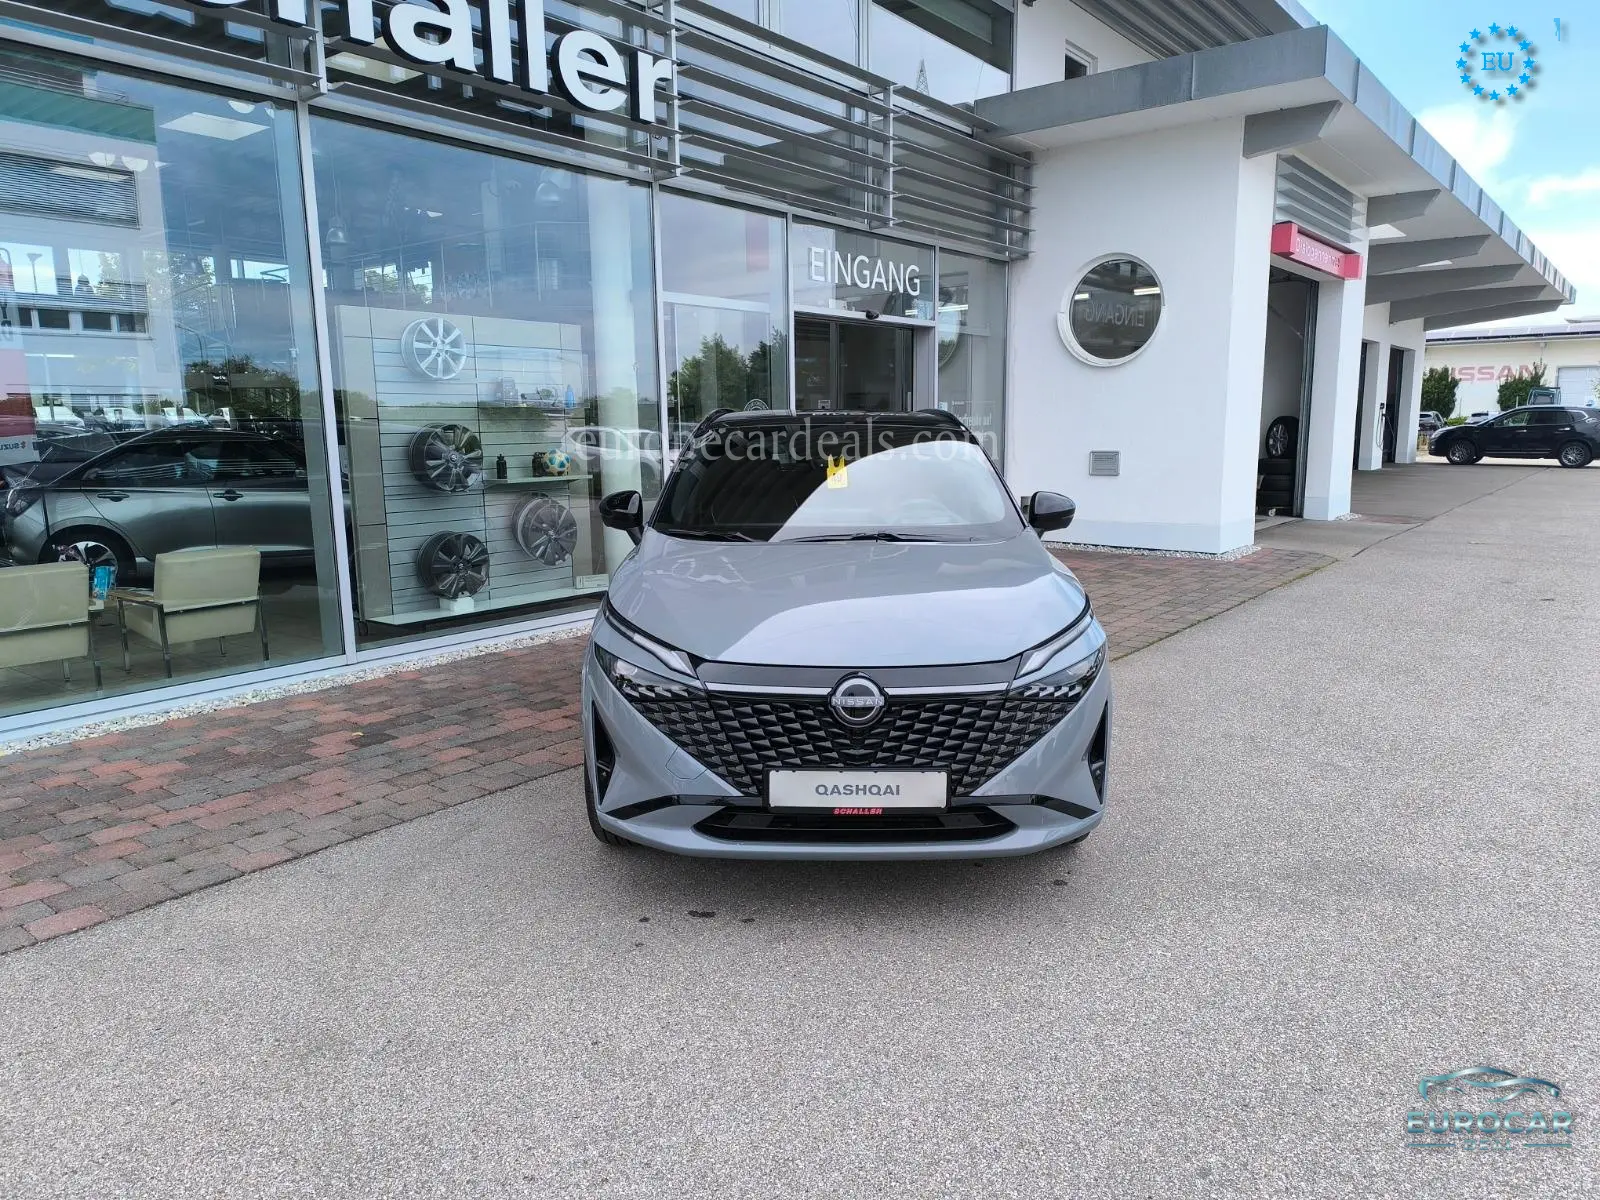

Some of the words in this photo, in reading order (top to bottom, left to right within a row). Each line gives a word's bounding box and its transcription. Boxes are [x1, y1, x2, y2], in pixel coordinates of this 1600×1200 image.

[811, 246, 920, 296] EINGANG
[1448, 364, 1535, 381] ISSAN
[832, 698, 883, 706] NISSAN
[815, 784, 900, 796] QASHQAI
